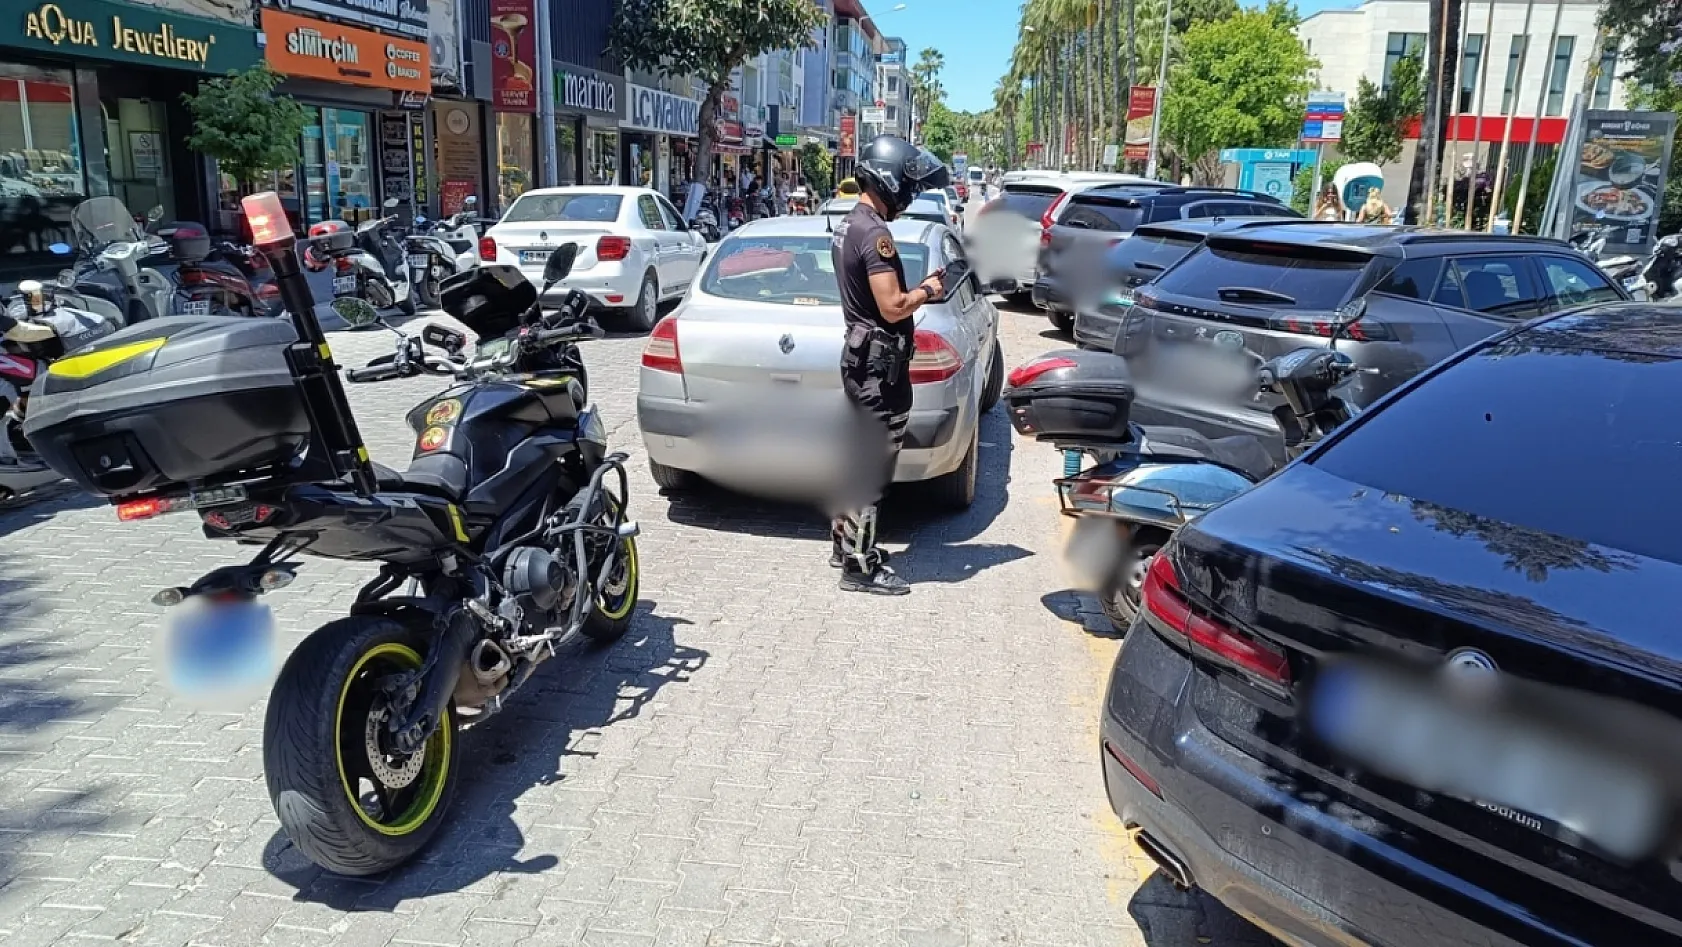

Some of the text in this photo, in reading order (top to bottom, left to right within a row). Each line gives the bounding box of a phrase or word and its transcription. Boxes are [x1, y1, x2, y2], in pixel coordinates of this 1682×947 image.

[27, 3, 98, 47] AQUA
[397, 49, 421, 62] COFFEE
[397, 66, 421, 79] BAKERY
